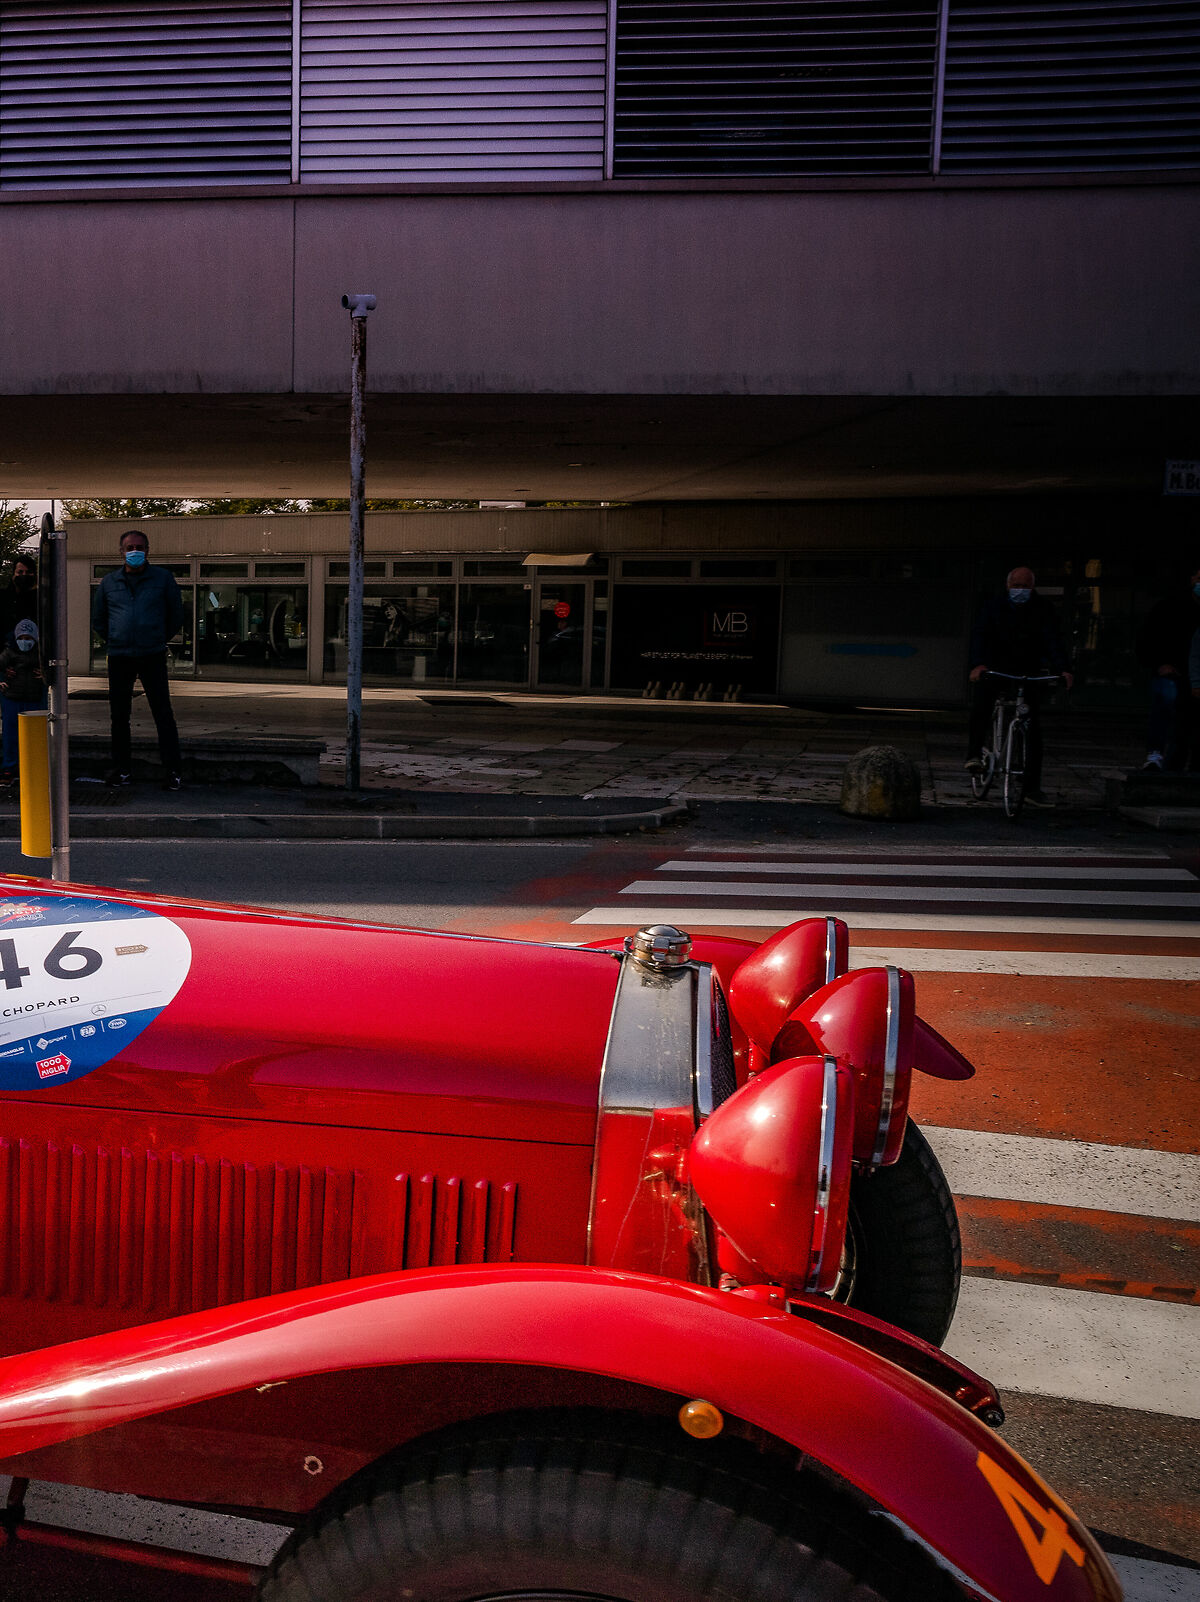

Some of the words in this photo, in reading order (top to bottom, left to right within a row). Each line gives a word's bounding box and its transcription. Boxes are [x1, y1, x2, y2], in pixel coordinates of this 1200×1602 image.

[713, 612, 748, 632] MB
[2, 995, 81, 1017] CHOPARD
[40, 1057, 62, 1069] 1000
[41, 1064, 66, 1077] MIGLIA
[976, 1450, 1085, 1586] 4
